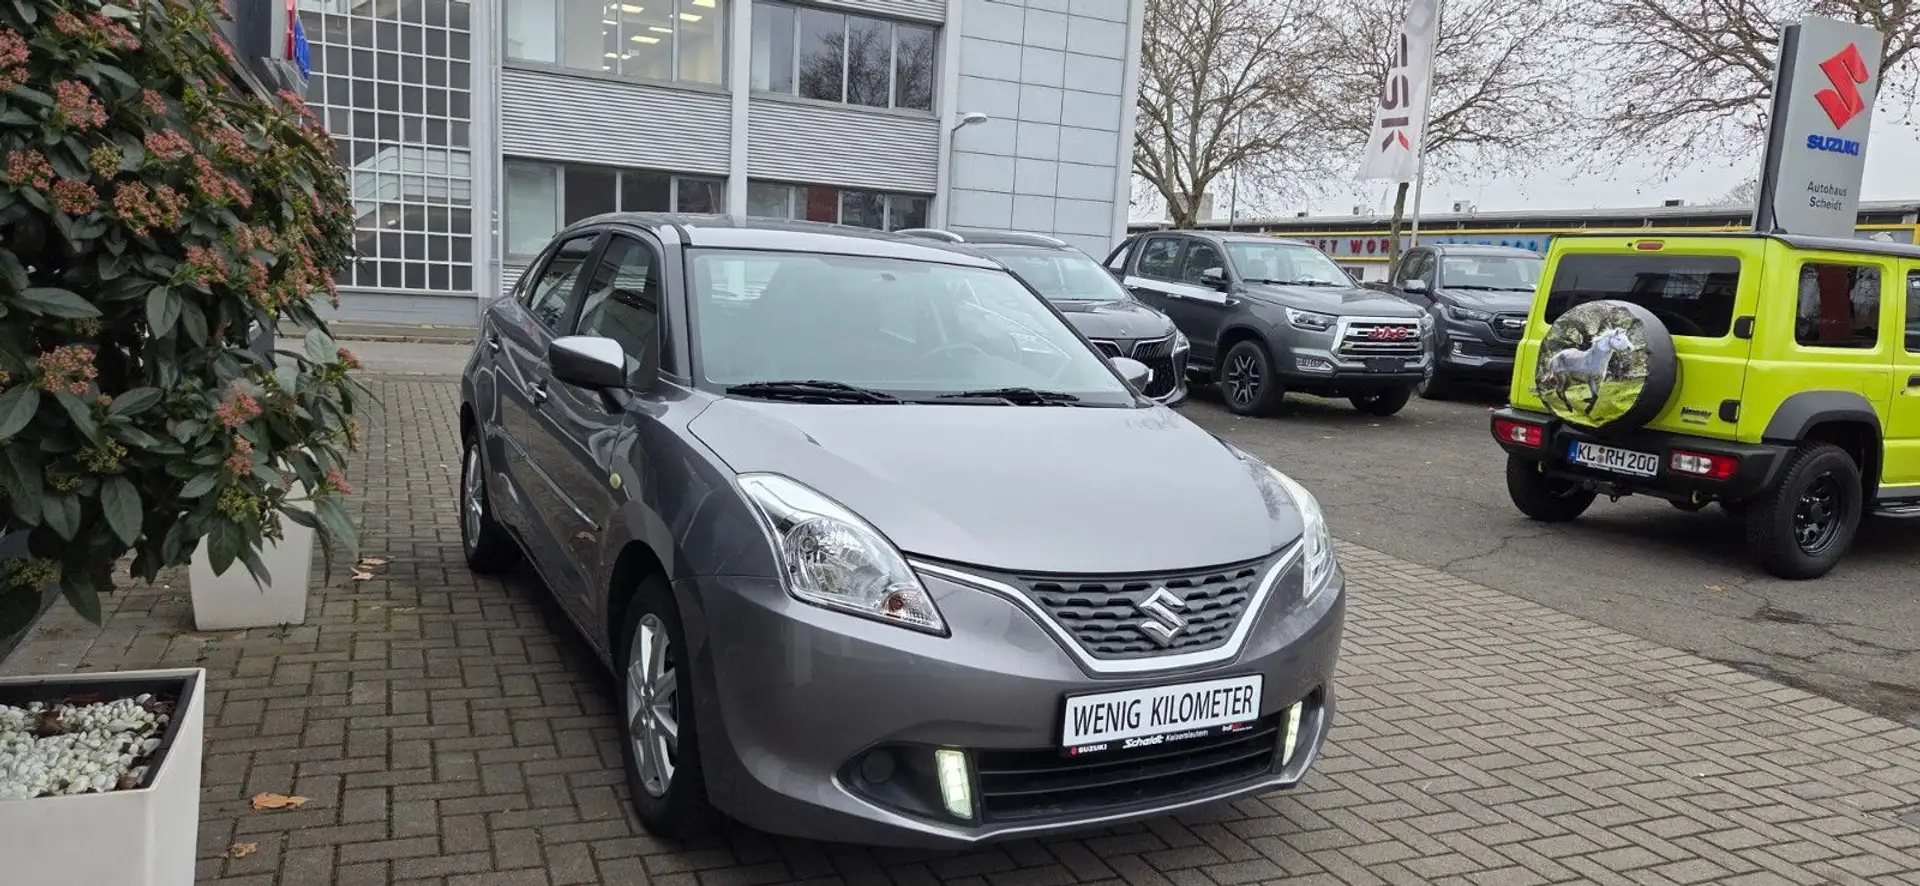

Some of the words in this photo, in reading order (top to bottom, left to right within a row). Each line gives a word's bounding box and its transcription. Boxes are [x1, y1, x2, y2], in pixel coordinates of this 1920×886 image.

[1806, 134, 1860, 156] SUZUKI
[1806, 181, 1848, 197] Autohaus
[1809, 196, 1843, 211] Scheidt
[1368, 326, 1408, 340] JAC
[1577, 443, 1596, 462] KL
[1605, 449, 1626, 466] RH
[1627, 454, 1656, 472] 200
[1073, 699, 1141, 737] WENIG
[1150, 685, 1254, 727] KILOMETER
[1078, 743, 1108, 754] SUZUKI
